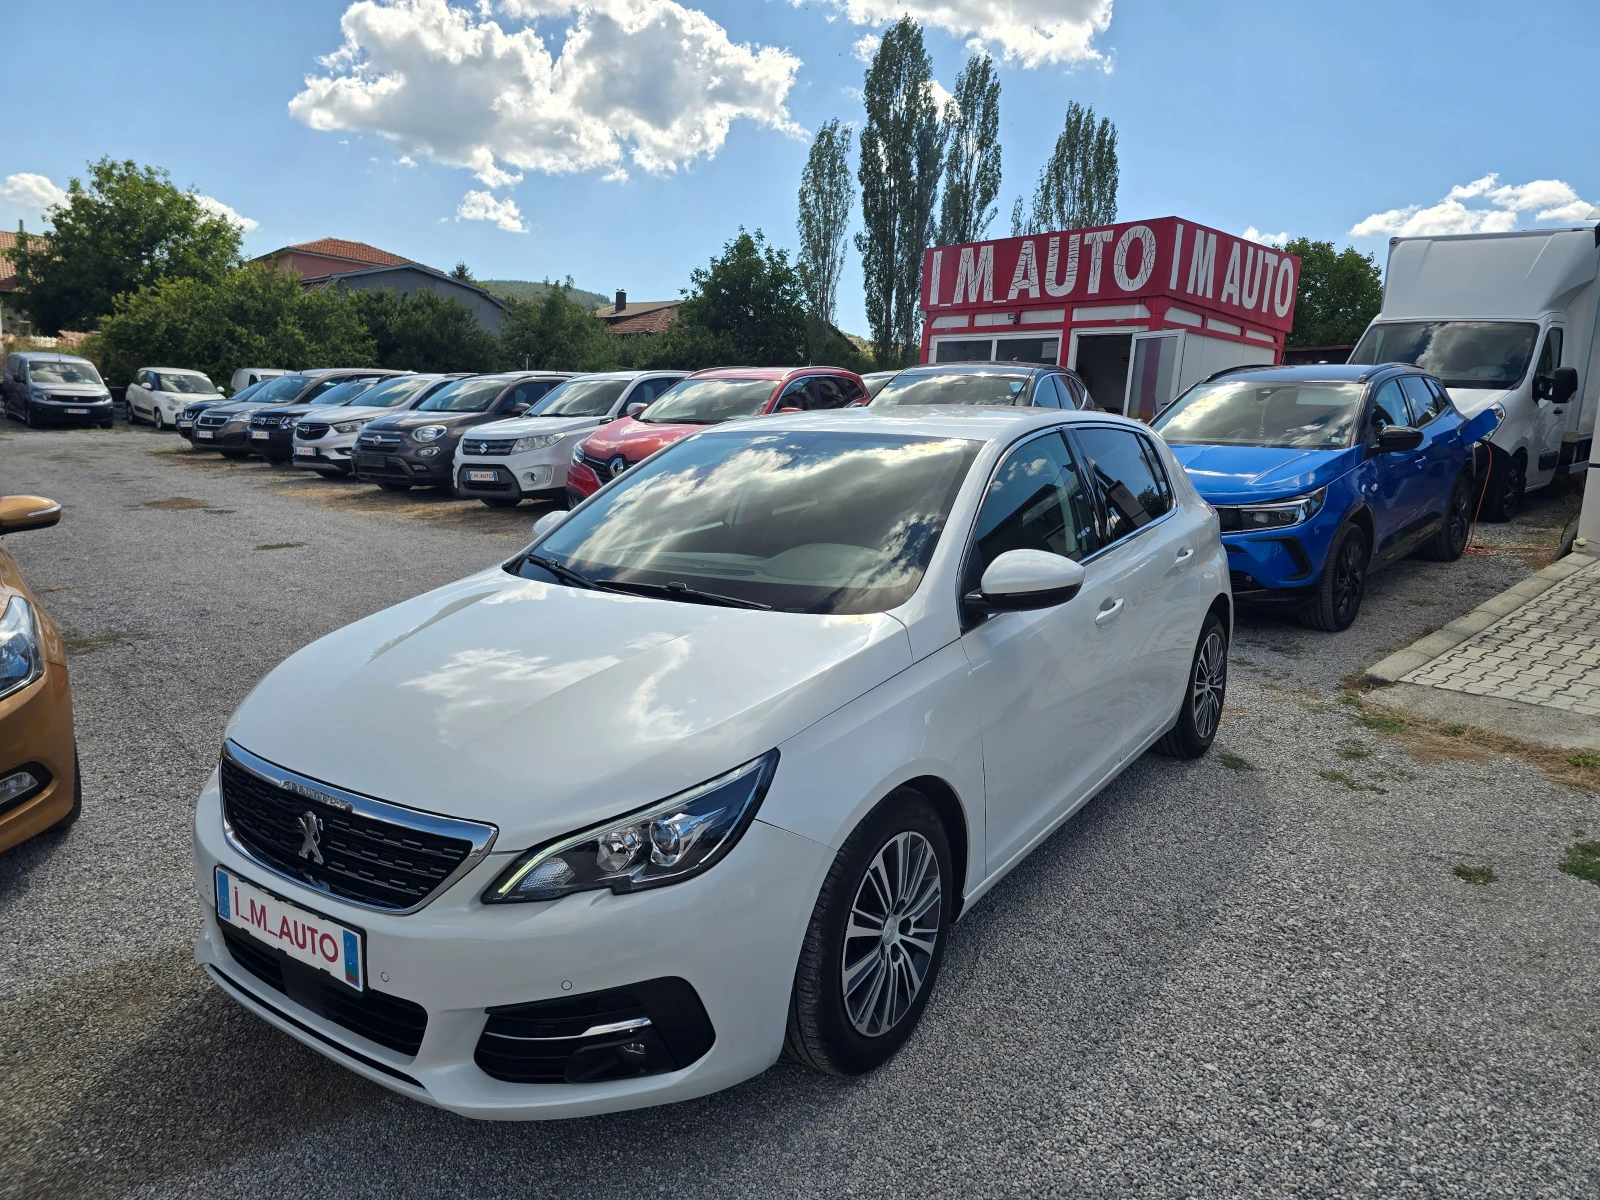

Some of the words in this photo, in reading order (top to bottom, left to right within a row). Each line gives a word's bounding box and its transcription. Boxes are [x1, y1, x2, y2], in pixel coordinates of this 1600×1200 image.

[1169, 223, 1184, 290] I
[1186, 229, 1218, 299] M
[1220, 242, 1294, 318] AUTO
